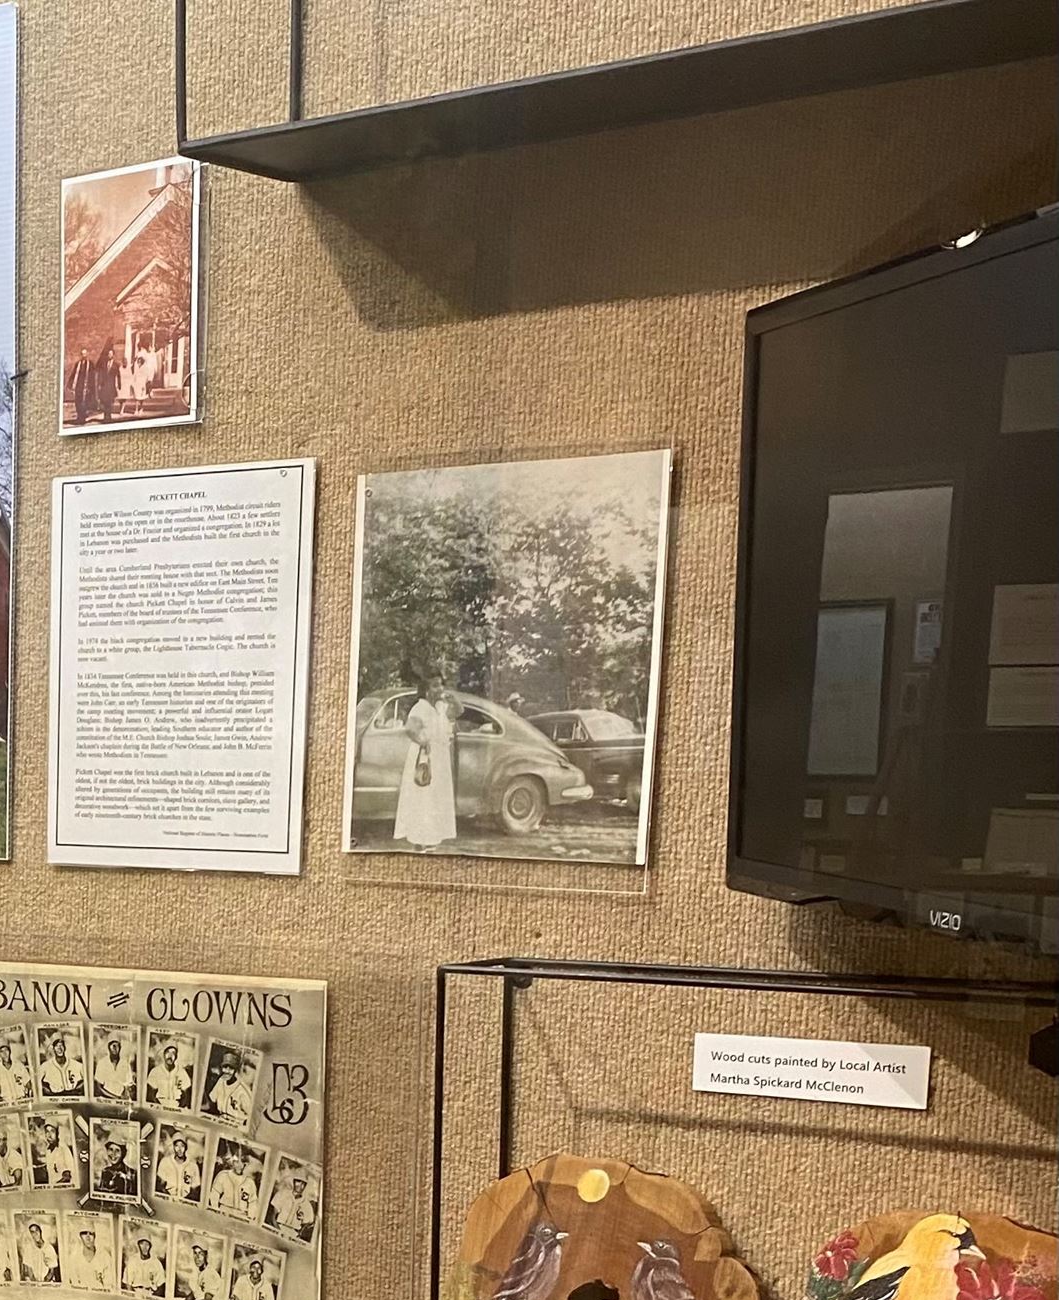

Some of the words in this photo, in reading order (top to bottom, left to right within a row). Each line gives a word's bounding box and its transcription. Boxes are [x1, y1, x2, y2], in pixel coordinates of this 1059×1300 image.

[149, 493, 178, 502] PICKETT
[179, 491, 205, 500] CHAPEL
[930, 910, 961, 931] VIZIO
[146, 987, 292, 1028] CLOWNS
[711, 1051, 745, 1062] Wood
[748, 1056, 771, 1065] cuts
[774, 1056, 818, 1068] painted
[822, 1058, 836, 1072] by
[840, 1060, 870, 1071] Local
[873, 1062, 906, 1074] Artist
[710, 1073, 750, 1085] Martha
[753, 1076, 802, 1089] Spickard
[806, 1080, 864, 1094] McClenon
